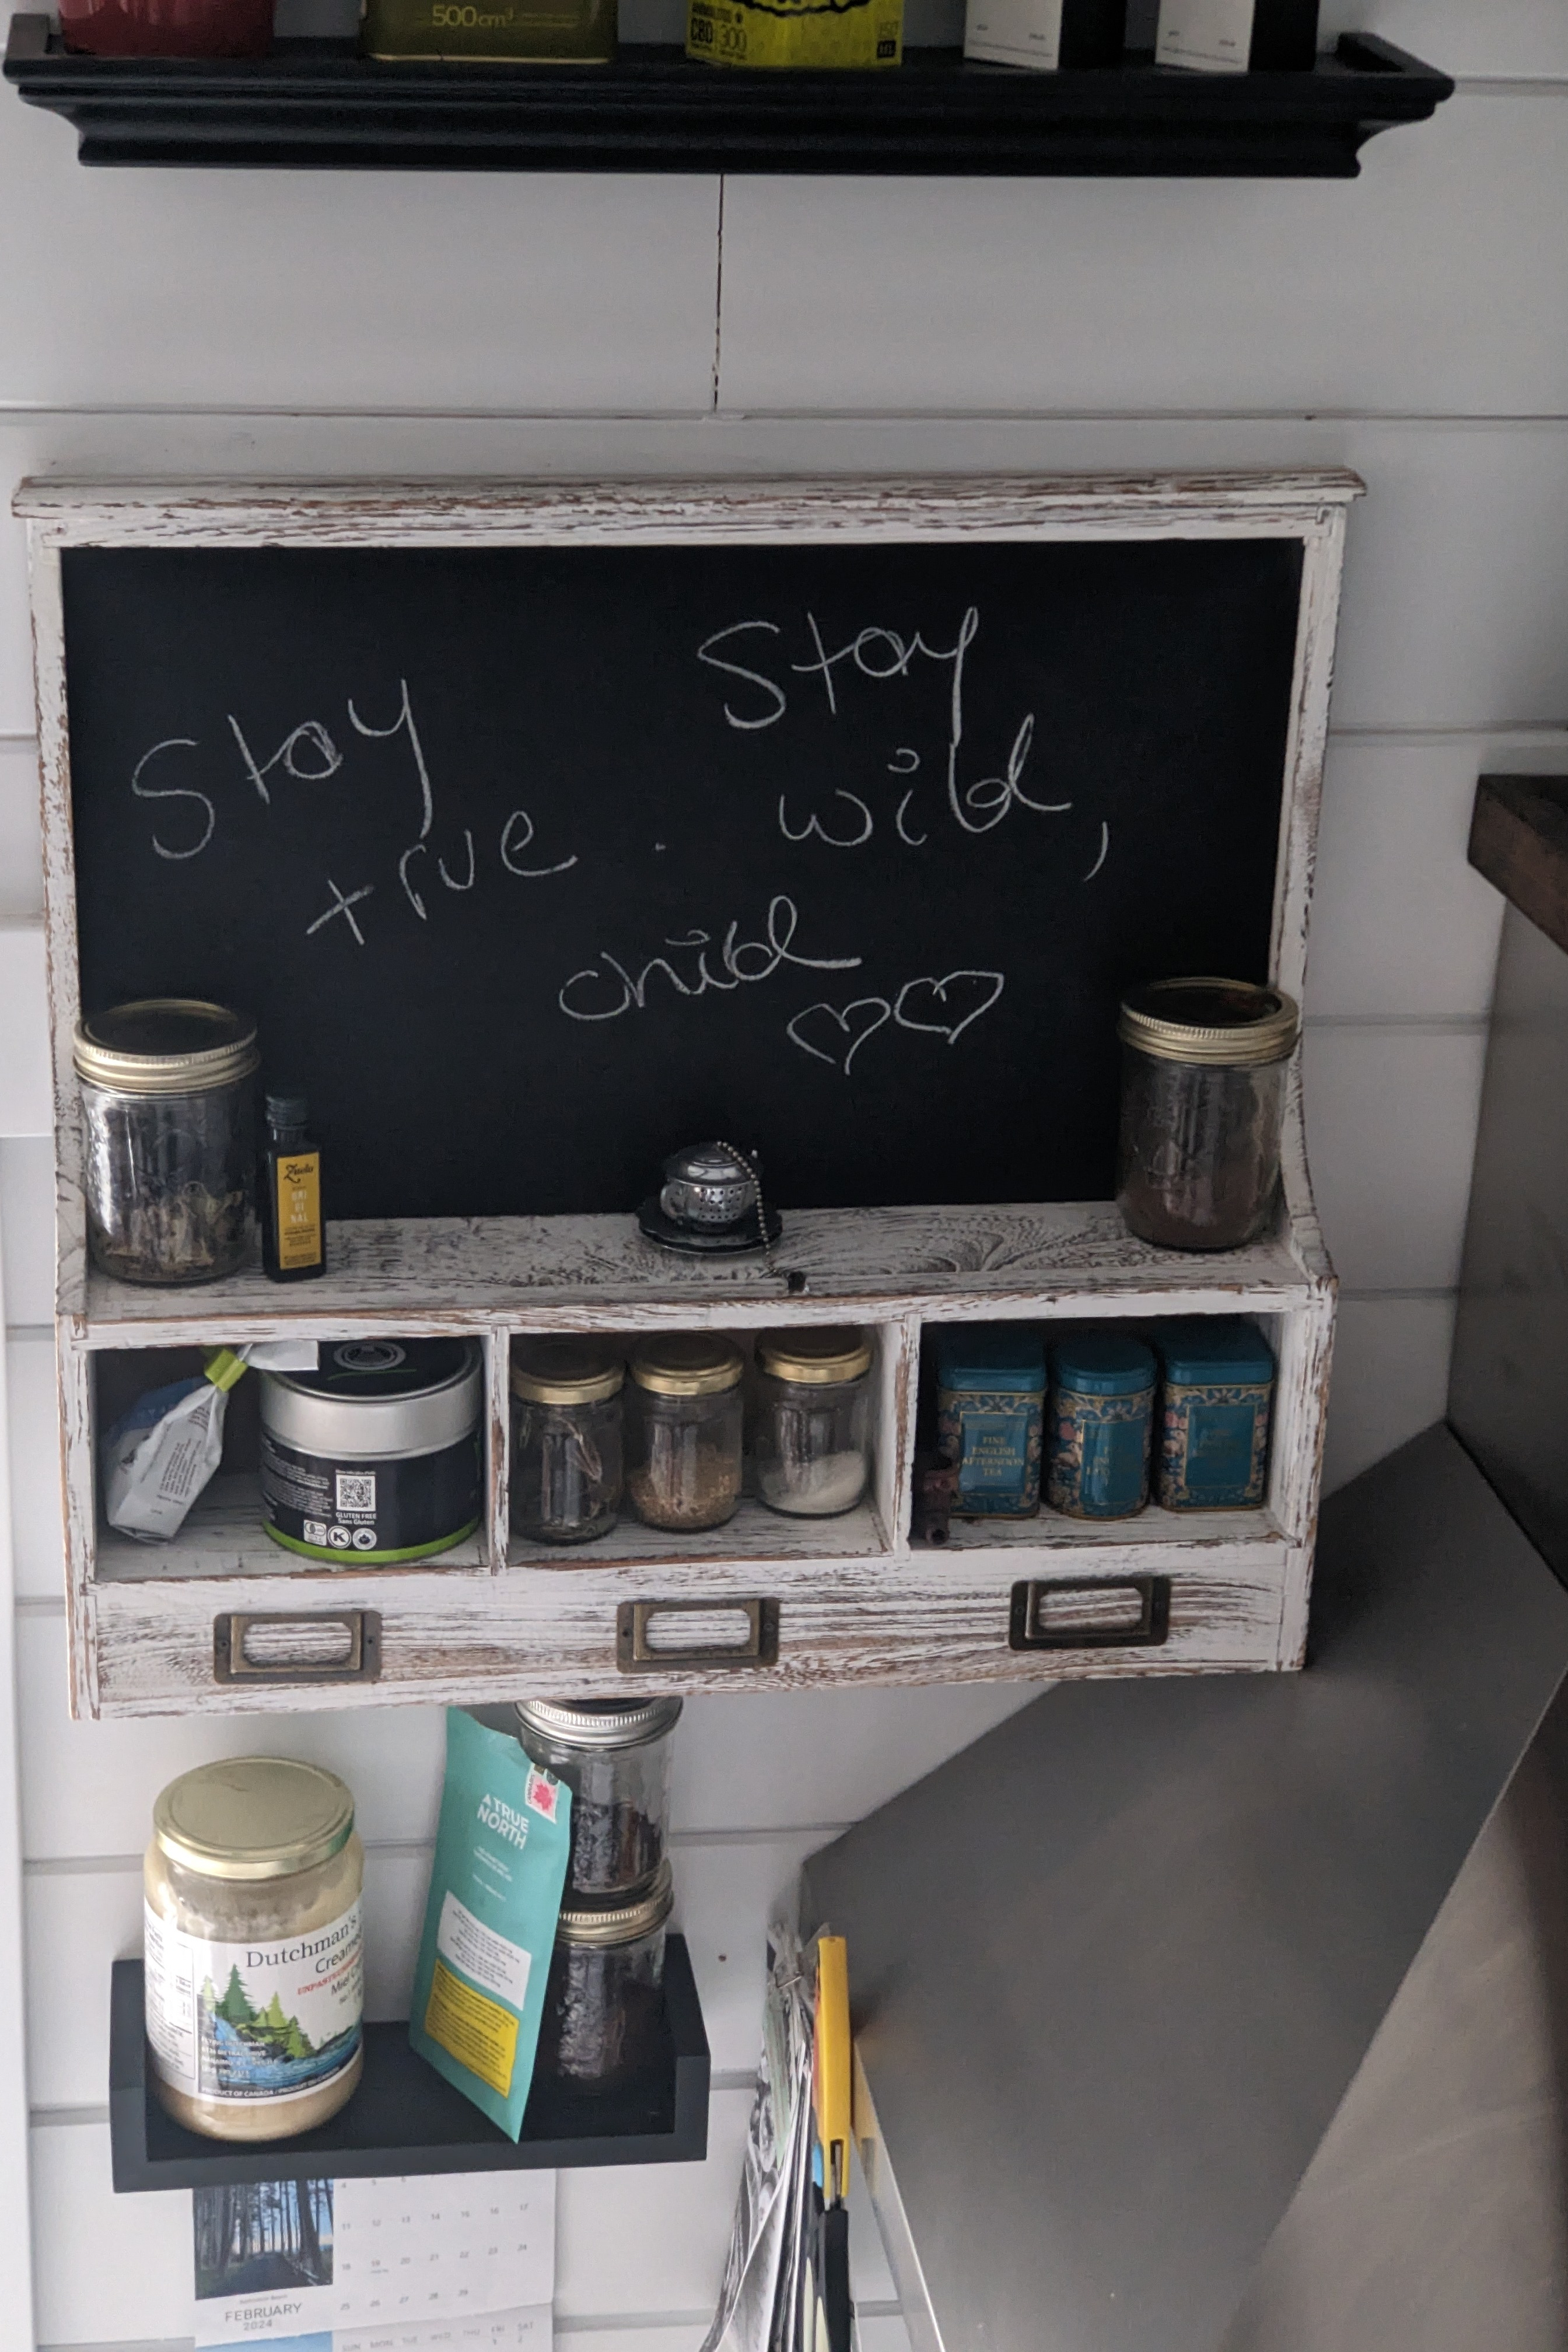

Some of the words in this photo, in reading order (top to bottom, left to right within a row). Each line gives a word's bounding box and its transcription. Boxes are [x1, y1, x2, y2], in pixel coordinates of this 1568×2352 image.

[698, 606, 979, 747] Stay
[131, 678, 433, 859] Stay
[559, 894, 862, 1020] child
[983, 1436, 1006, 1444] FINE
[972, 1447, 1016, 1456] ENGLISH
[963, 1457, 1024, 1466] AFTERNOON
[984, 1467, 1002, 1476] TEA
[492, 1796, 530, 1835] TRUE
[476, 1803, 527, 1850] NORTH
[246, 1914, 357, 1968] Dutchman's
[225, 2303, 302, 2322] FEBRUARY
[243, 2319, 272, 2331] 2024
[517, 2321, 533, 2331] SAT
